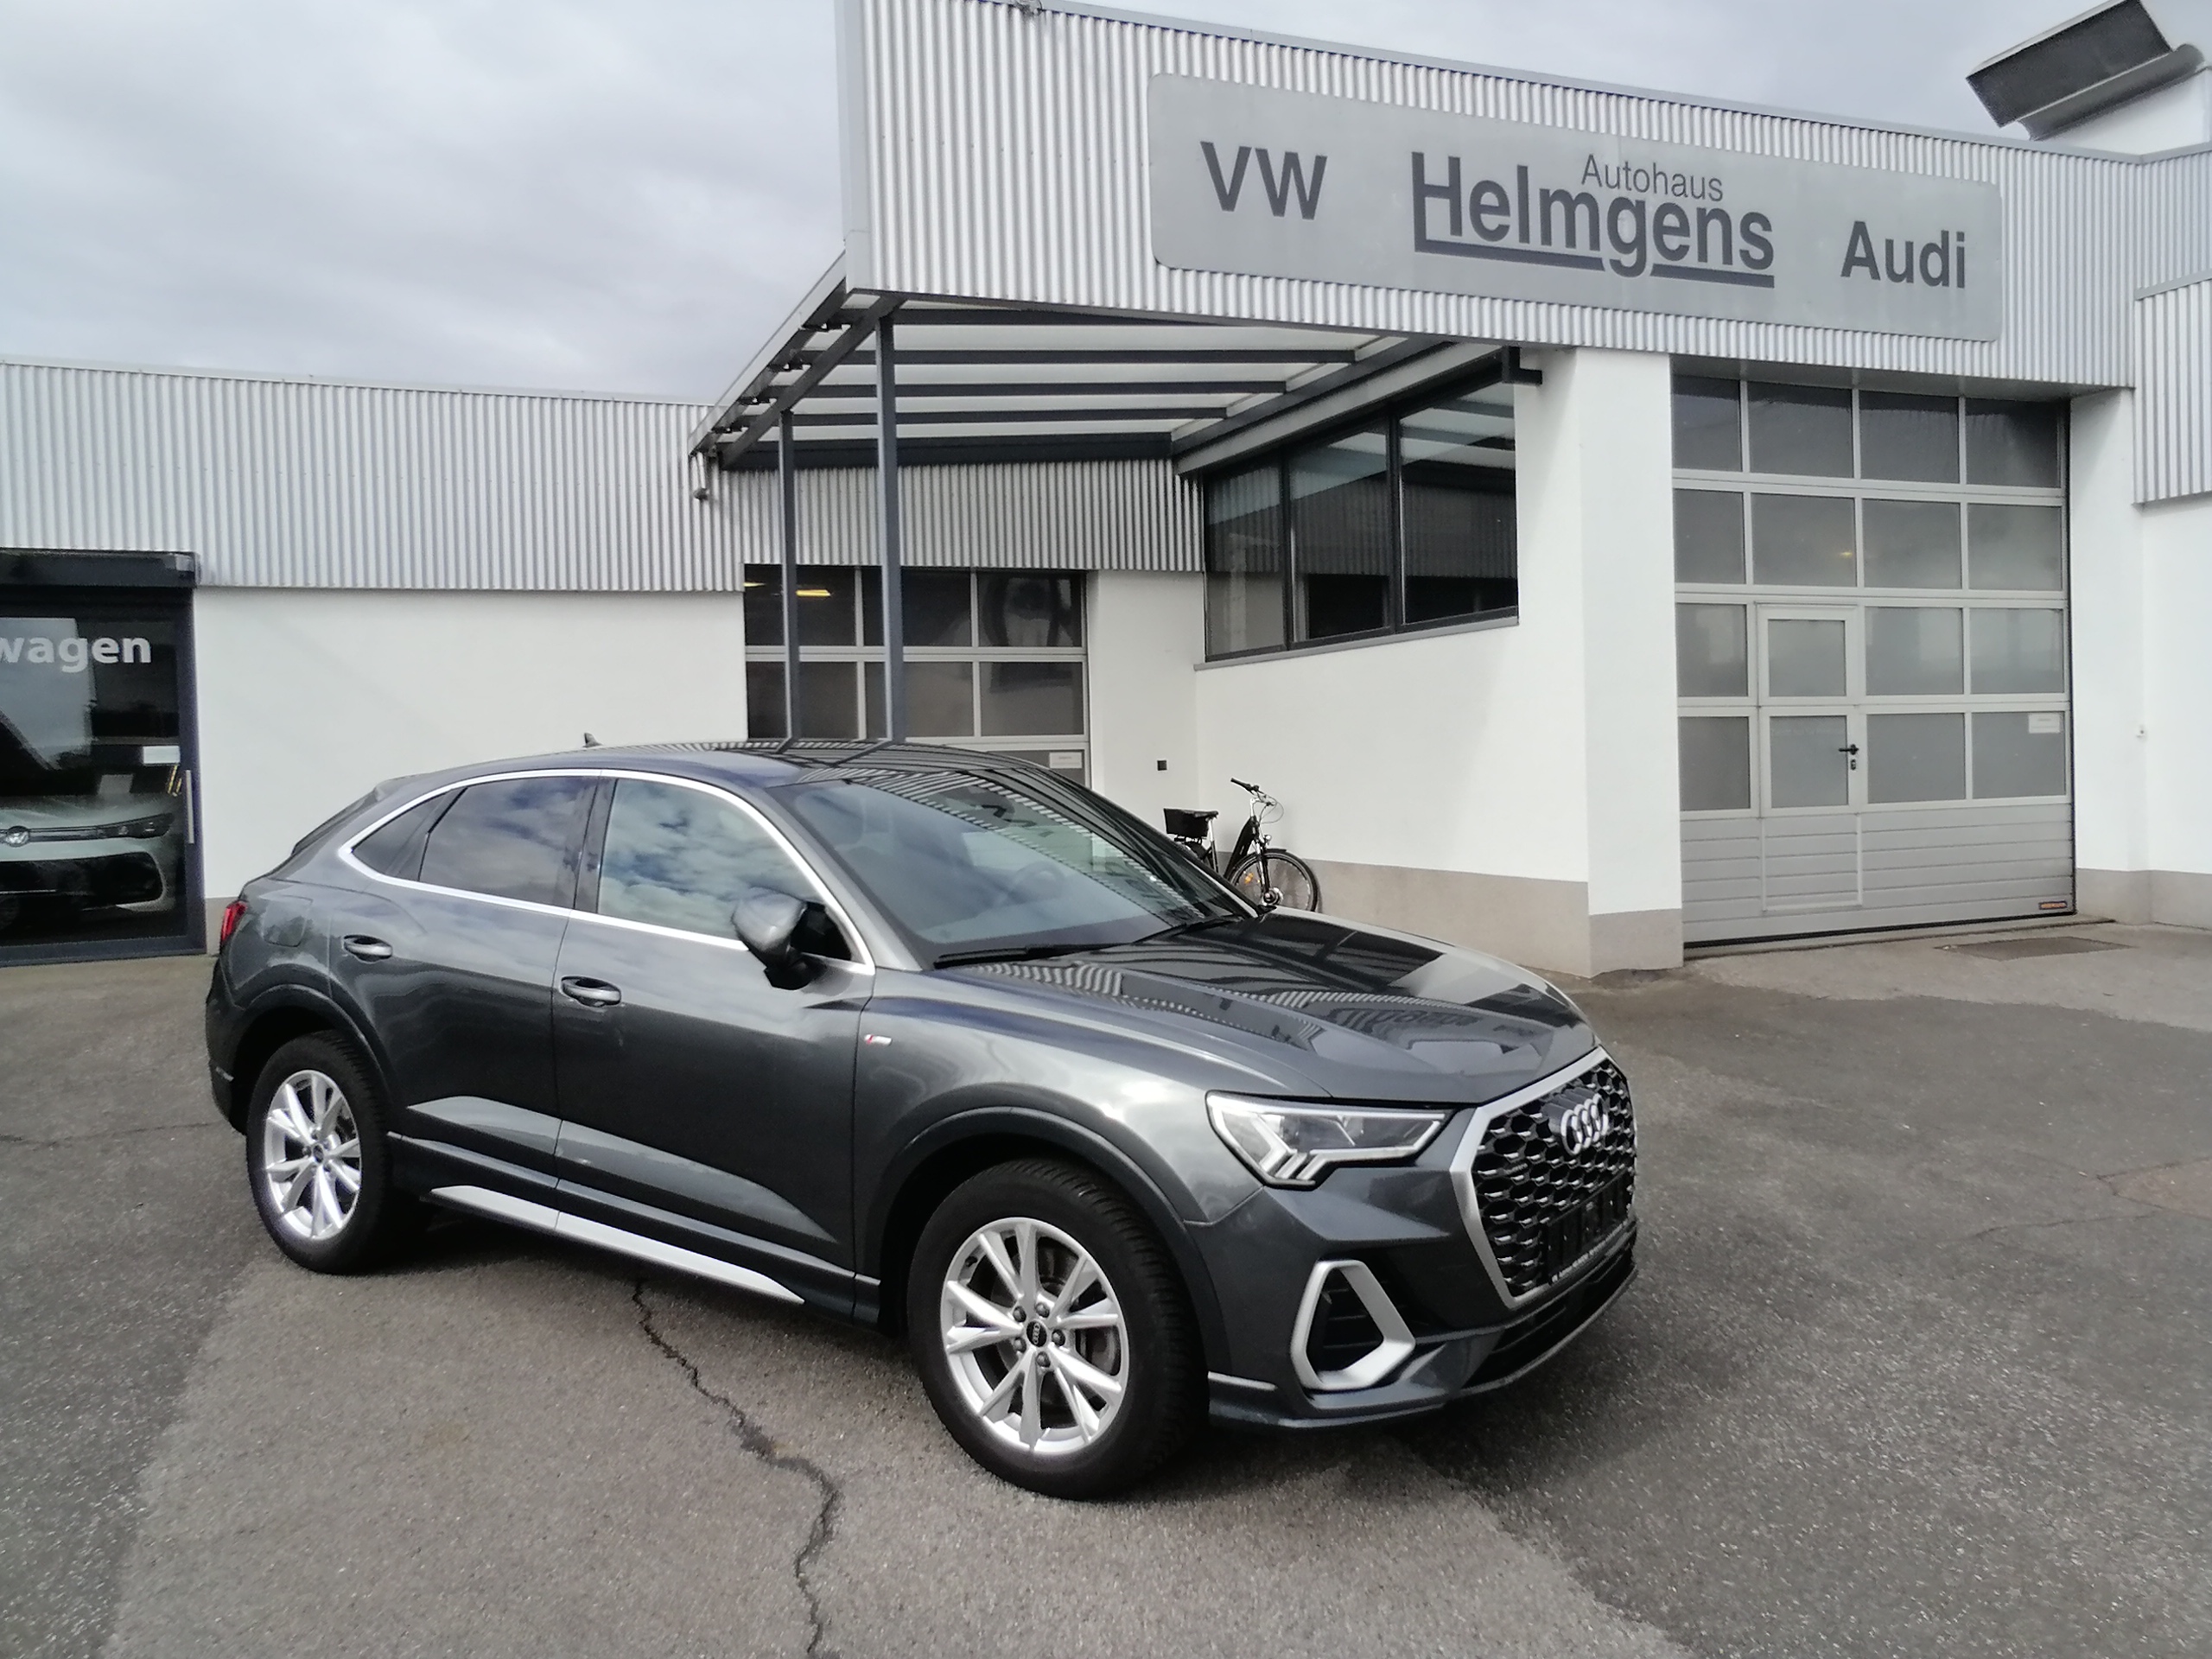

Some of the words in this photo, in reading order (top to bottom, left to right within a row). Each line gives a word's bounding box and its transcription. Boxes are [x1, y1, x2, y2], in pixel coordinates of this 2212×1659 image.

[1199, 141, 1328, 220] VW
[1411, 151, 1775, 280] Helmgens
[1580, 154, 1724, 203] Autohaus
[1840, 220, 1966, 289] Audi
